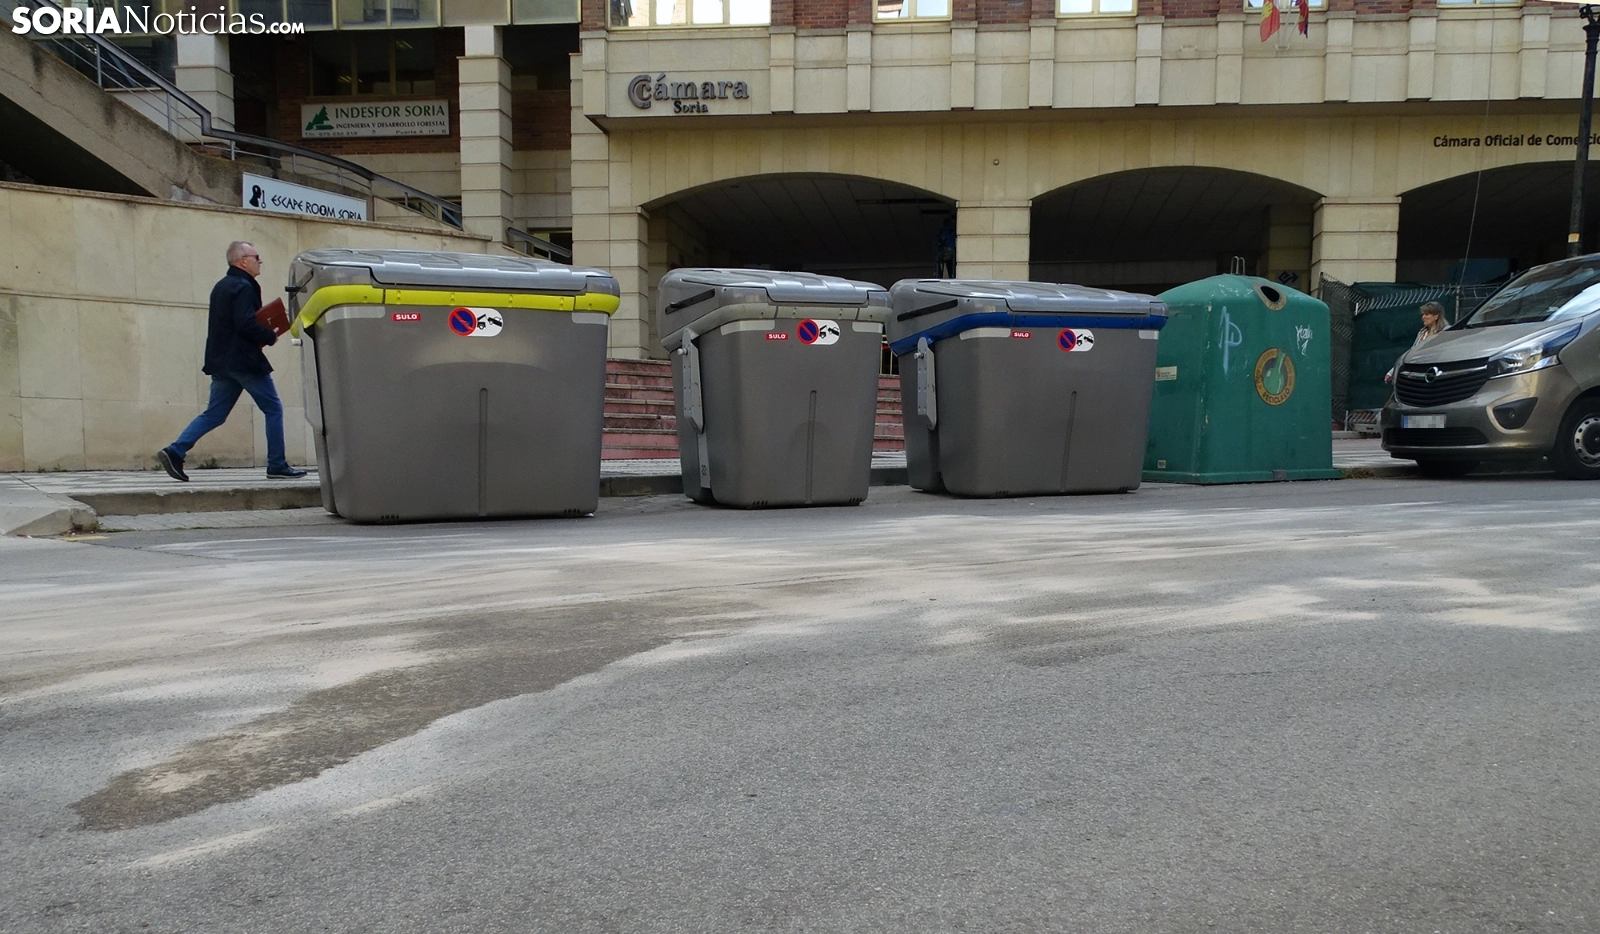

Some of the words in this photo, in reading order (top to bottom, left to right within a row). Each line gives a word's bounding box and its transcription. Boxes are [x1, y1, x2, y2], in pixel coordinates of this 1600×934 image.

[628, 73, 749, 109] Cámara
[335, 105, 401, 119] INDESFOR
[405, 104, 446, 117] SORIA
[673, 99, 709, 114] Soria
[1433, 135, 1481, 148] Cámara
[1484, 134, 1524, 147] Oficial
[1527, 134, 1542, 146] de
[271, 194, 303, 212] ESCAPE
[305, 201, 336, 218] ROOM
